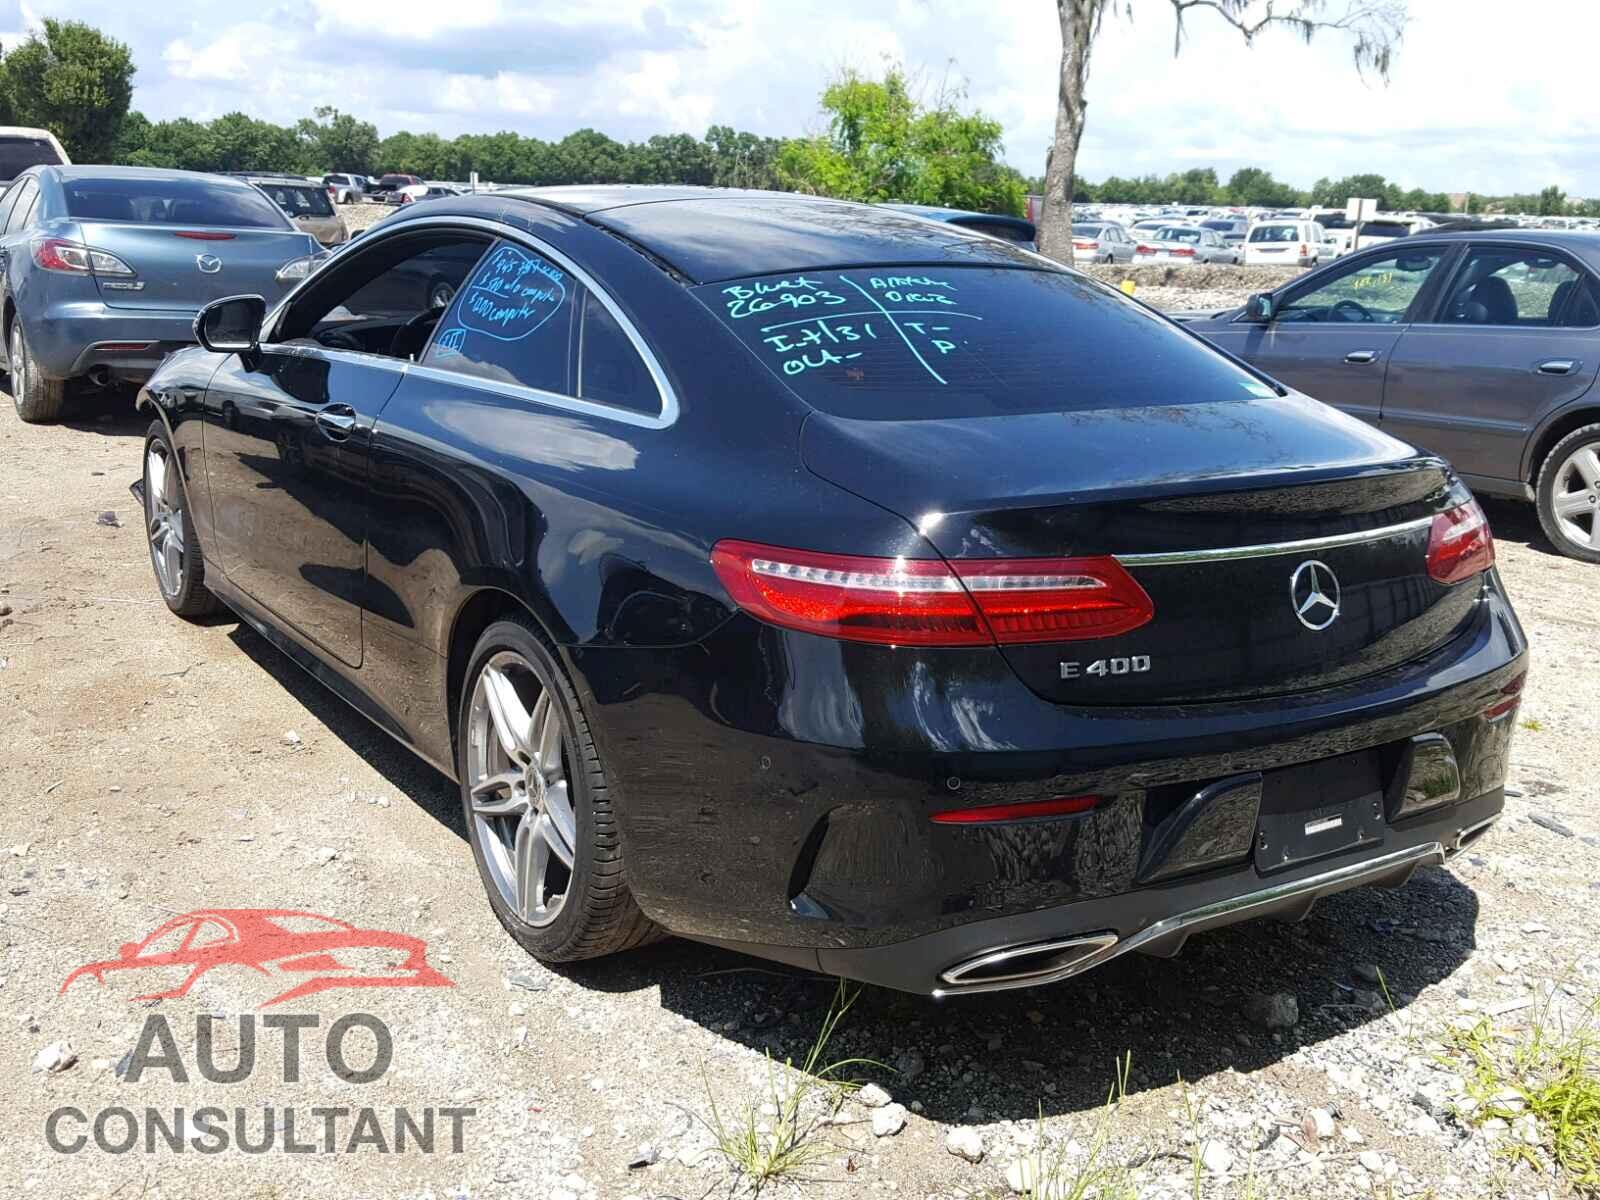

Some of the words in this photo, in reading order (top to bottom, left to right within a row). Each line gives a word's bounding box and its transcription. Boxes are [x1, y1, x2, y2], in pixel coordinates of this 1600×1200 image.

[726, 290, 847, 319] 26903
[1060, 661, 1081, 679] E
[1085, 654, 1151, 678] 400
